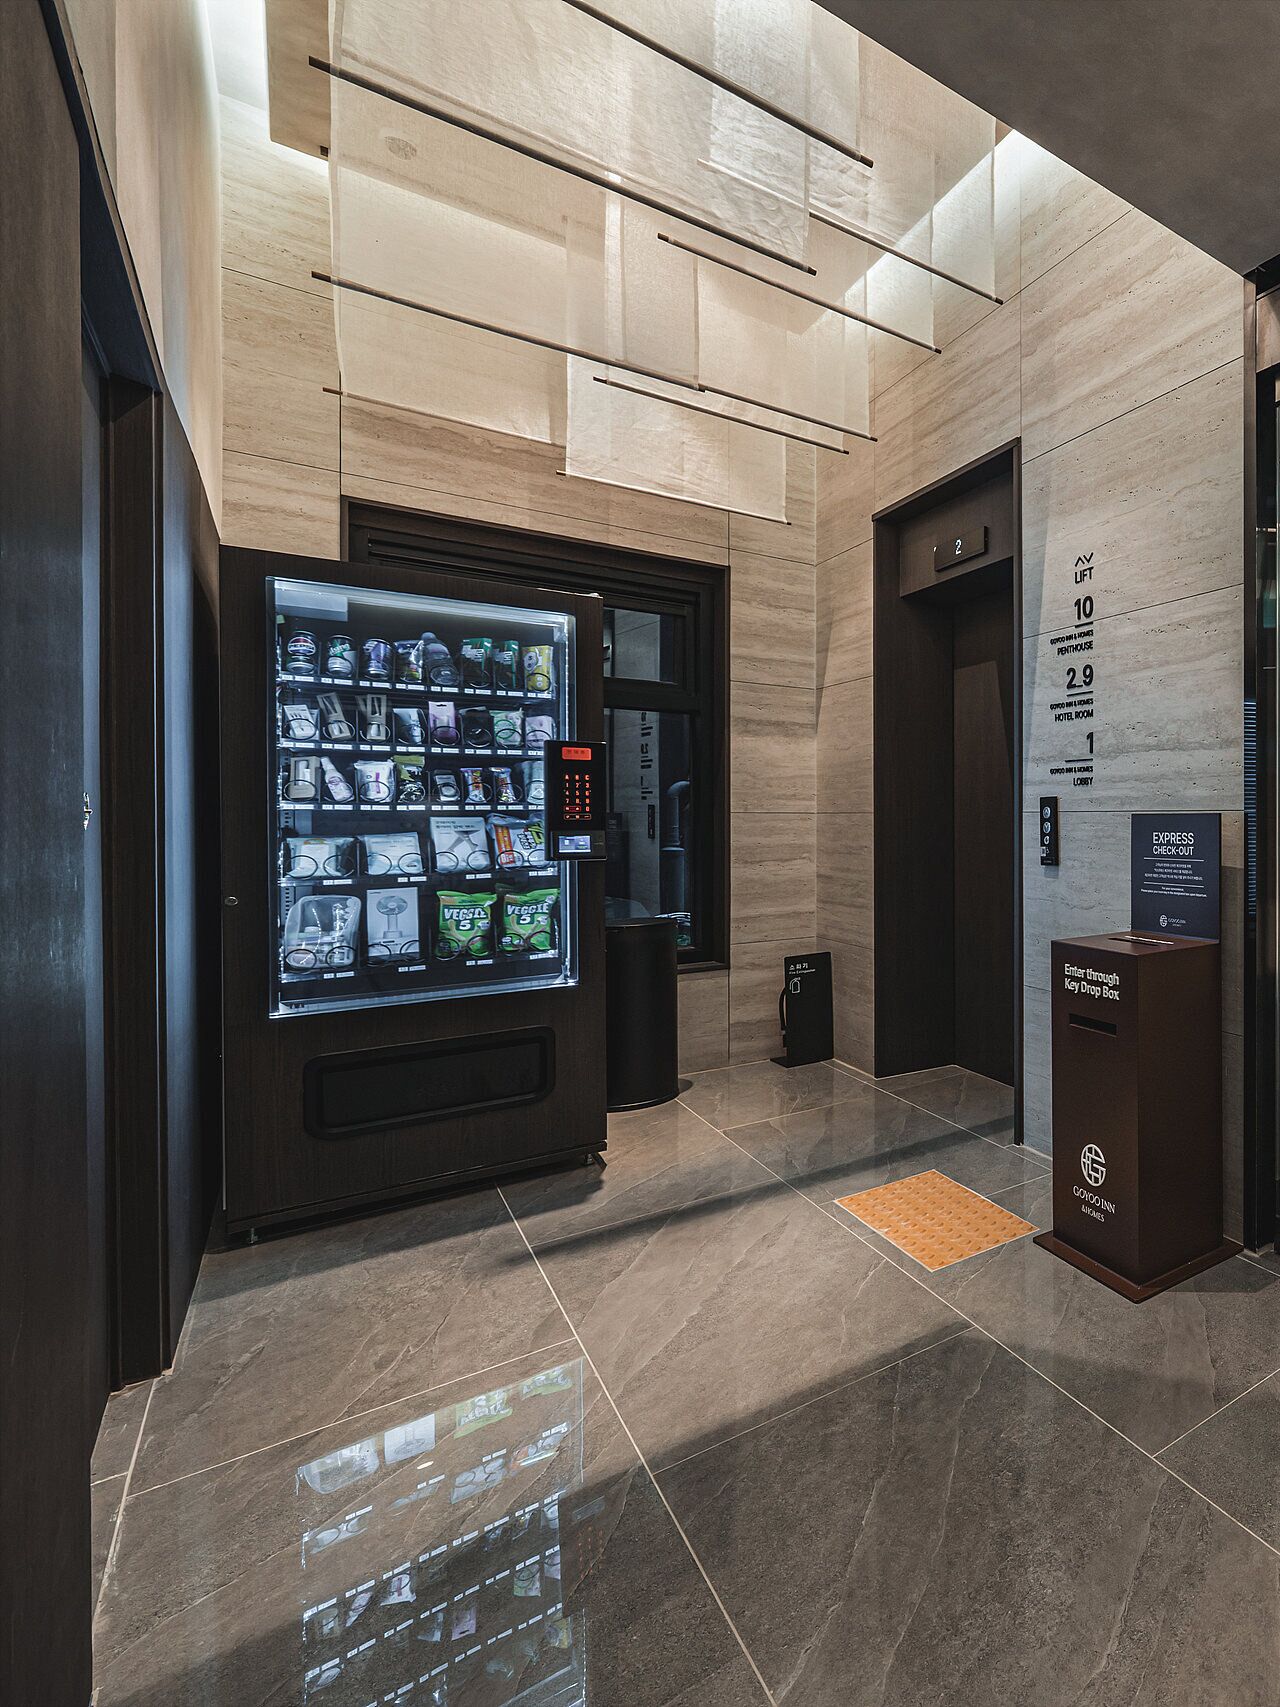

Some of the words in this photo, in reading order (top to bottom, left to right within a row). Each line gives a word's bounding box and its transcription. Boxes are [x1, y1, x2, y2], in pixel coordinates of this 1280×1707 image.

[955, 539, 961, 554] 2
[1075, 566, 1094, 584] LIFT
[1074, 596, 1094, 620] 10
[1057, 640, 1093, 655] PENTHOUSE
[1055, 712, 1074, 722] HOTEL
[1075, 709, 1093, 719] ROOM
[1087, 732, 1094, 753] 1
[1073, 777, 1093, 786] LOBBY
[1153, 832, 1194, 844] EXPRESS
[1153, 846, 1194, 856] CHECK-OUT
[507, 903, 549, 915] VEGGIE
[460, 920, 471, 930] 5
[520, 914, 530, 924] 5
[1065, 963, 1085, 978] Enter
[1086, 968, 1119, 986] through
[1065, 978, 1080, 993] Key
[1081, 981, 1101, 998] Drop
[1103, 986, 1120, 1000] Box
[1073, 1185, 1101, 1206] GOYOO
[1101, 1198, 1115, 1213] INN
[1081, 1204, 1105, 1222] &HOMES
